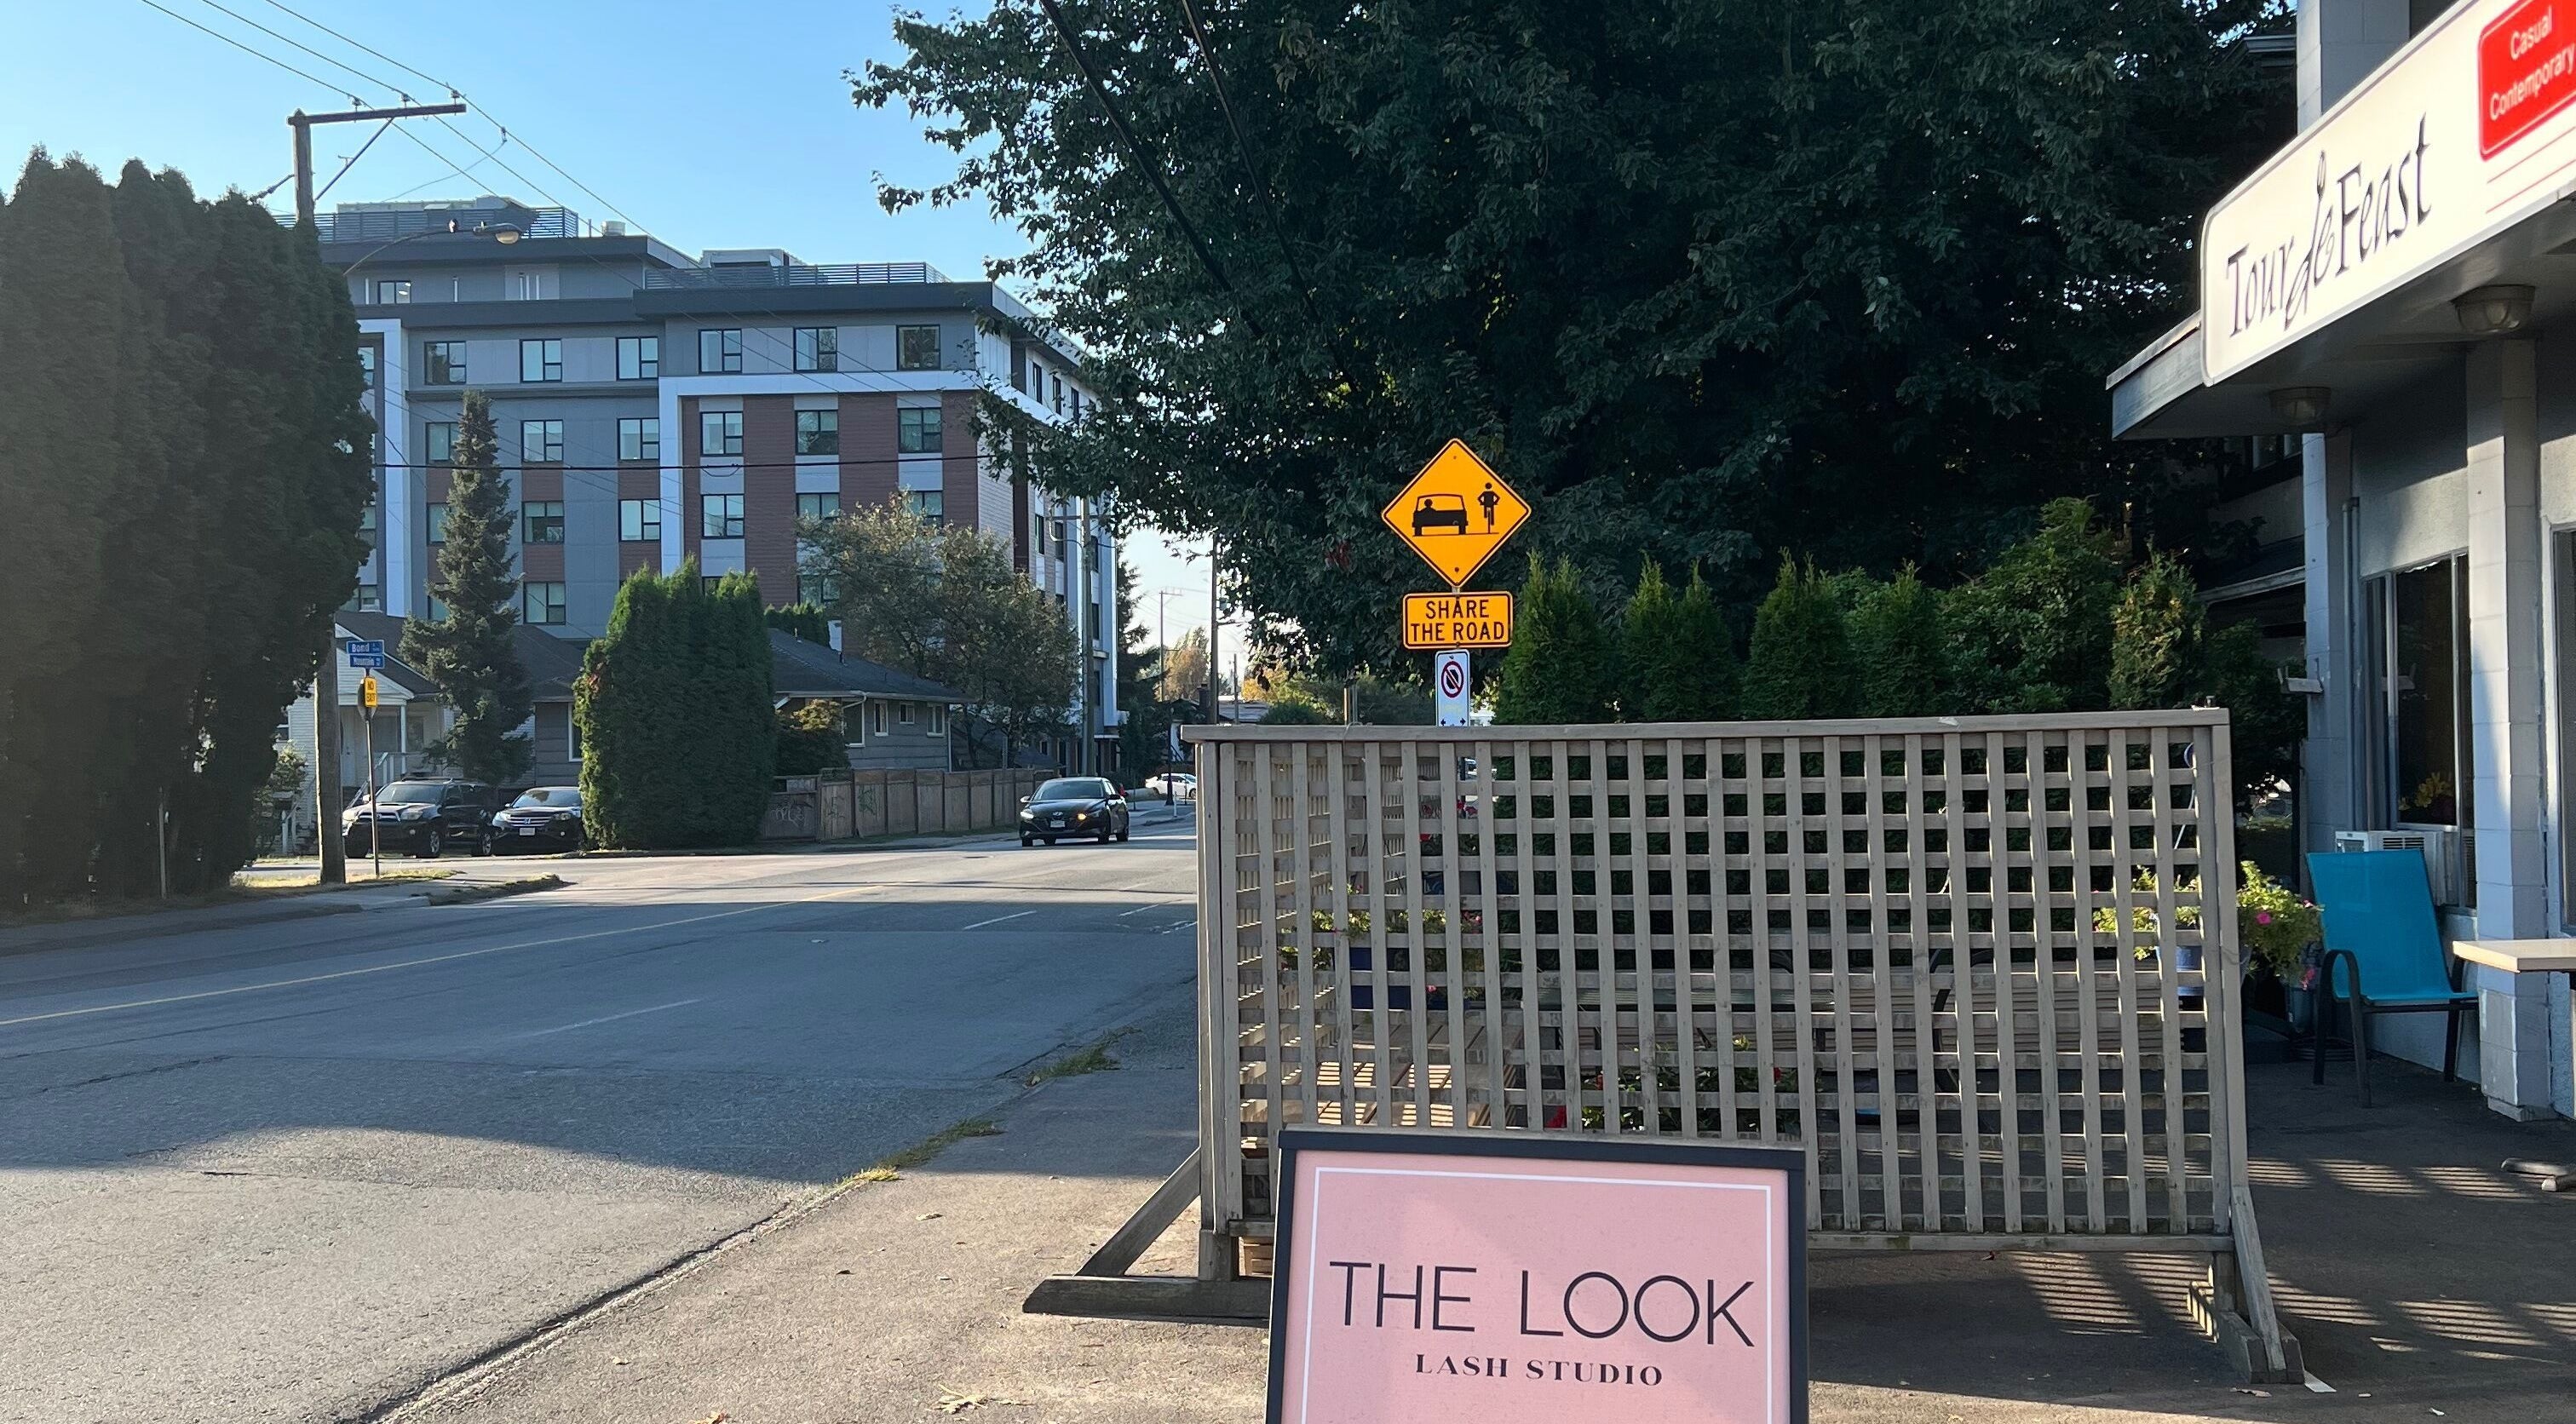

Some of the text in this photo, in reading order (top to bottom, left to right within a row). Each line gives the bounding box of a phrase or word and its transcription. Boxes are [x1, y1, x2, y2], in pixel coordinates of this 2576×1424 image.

[2510, 5, 2553, 60] Casual
[2489, 42, 2575, 122] Contemporary
[2226, 112, 2432, 338] Tour de Feast
[1411, 622, 1504, 642] THE ROAD
[1426, 600, 1489, 619] SHARE
[1330, 1260, 1756, 1347] THE LOOK
[1416, 1352, 1664, 1387] LASH STUDIO
